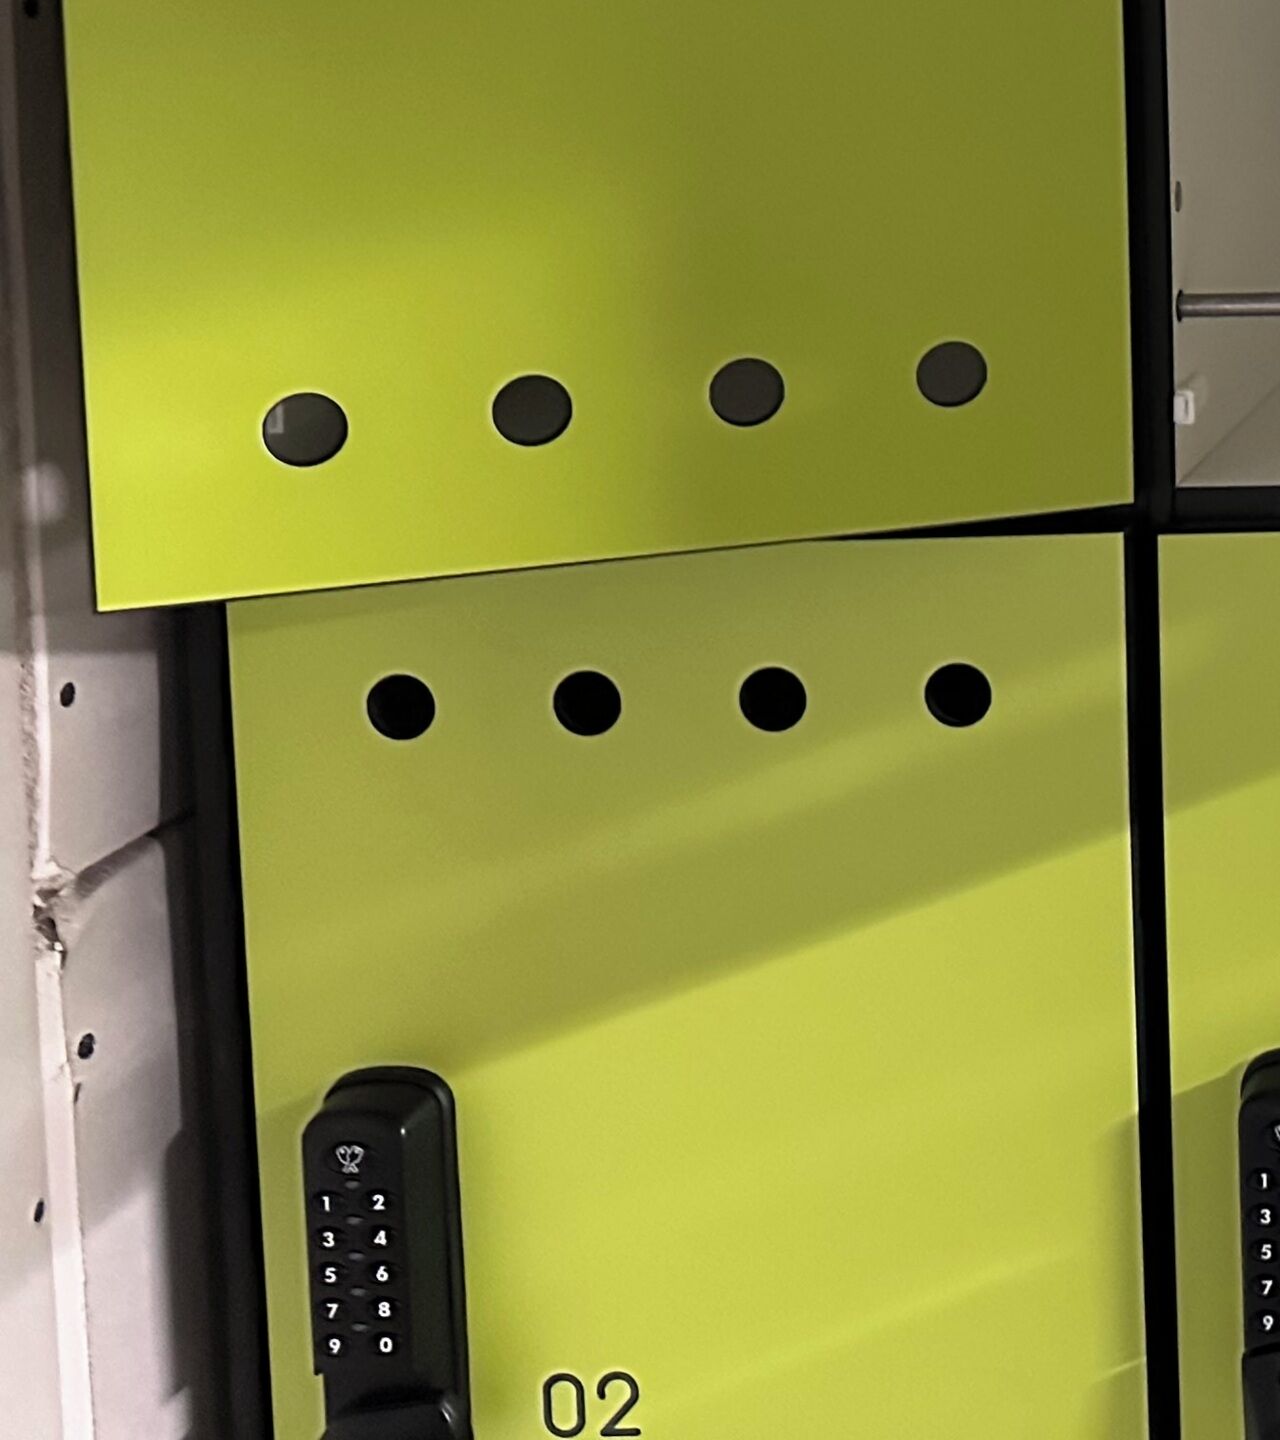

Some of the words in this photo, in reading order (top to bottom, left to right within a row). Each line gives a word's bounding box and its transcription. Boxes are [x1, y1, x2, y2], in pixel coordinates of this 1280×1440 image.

[1260, 1172, 1268, 1189] 1
[322, 1195, 331, 1212] 1
[372, 1193, 386, 1211] 2
[1260, 1208, 1271, 1225] 3
[322, 1231, 335, 1248] 3
[373, 1229, 388, 1246] 4
[1260, 1243, 1272, 1260] 5
[324, 1266, 337, 1284] 5
[375, 1265, 389, 1282] 6
[1261, 1279, 1273, 1296] 7
[326, 1303, 339, 1319] 7
[377, 1301, 391, 1318] 8
[1262, 1315, 1274, 1331] 9
[328, 1338, 342, 1355] 9
[379, 1336, 393, 1353] 0
[542, 1370, 642, 1439] 02
